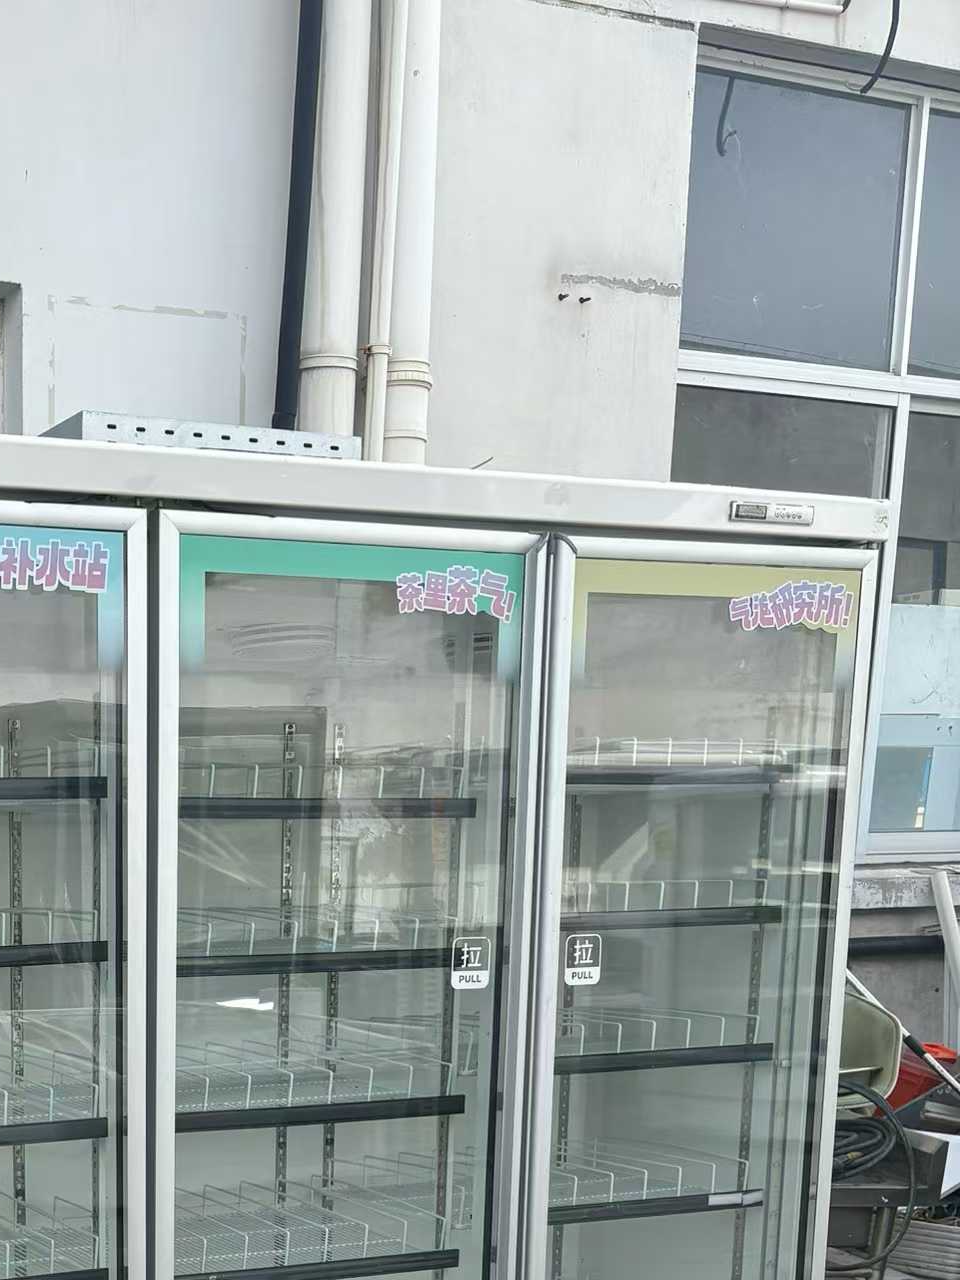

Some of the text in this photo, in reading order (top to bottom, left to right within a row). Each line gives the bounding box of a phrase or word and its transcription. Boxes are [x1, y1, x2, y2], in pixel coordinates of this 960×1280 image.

[396, 565, 517, 623] 茶里茶气!
[461, 942, 482, 968] 拉
[574, 940, 593, 965] 拉
[458, 974, 482, 983] PULL
[571, 971, 593, 980] PULL
